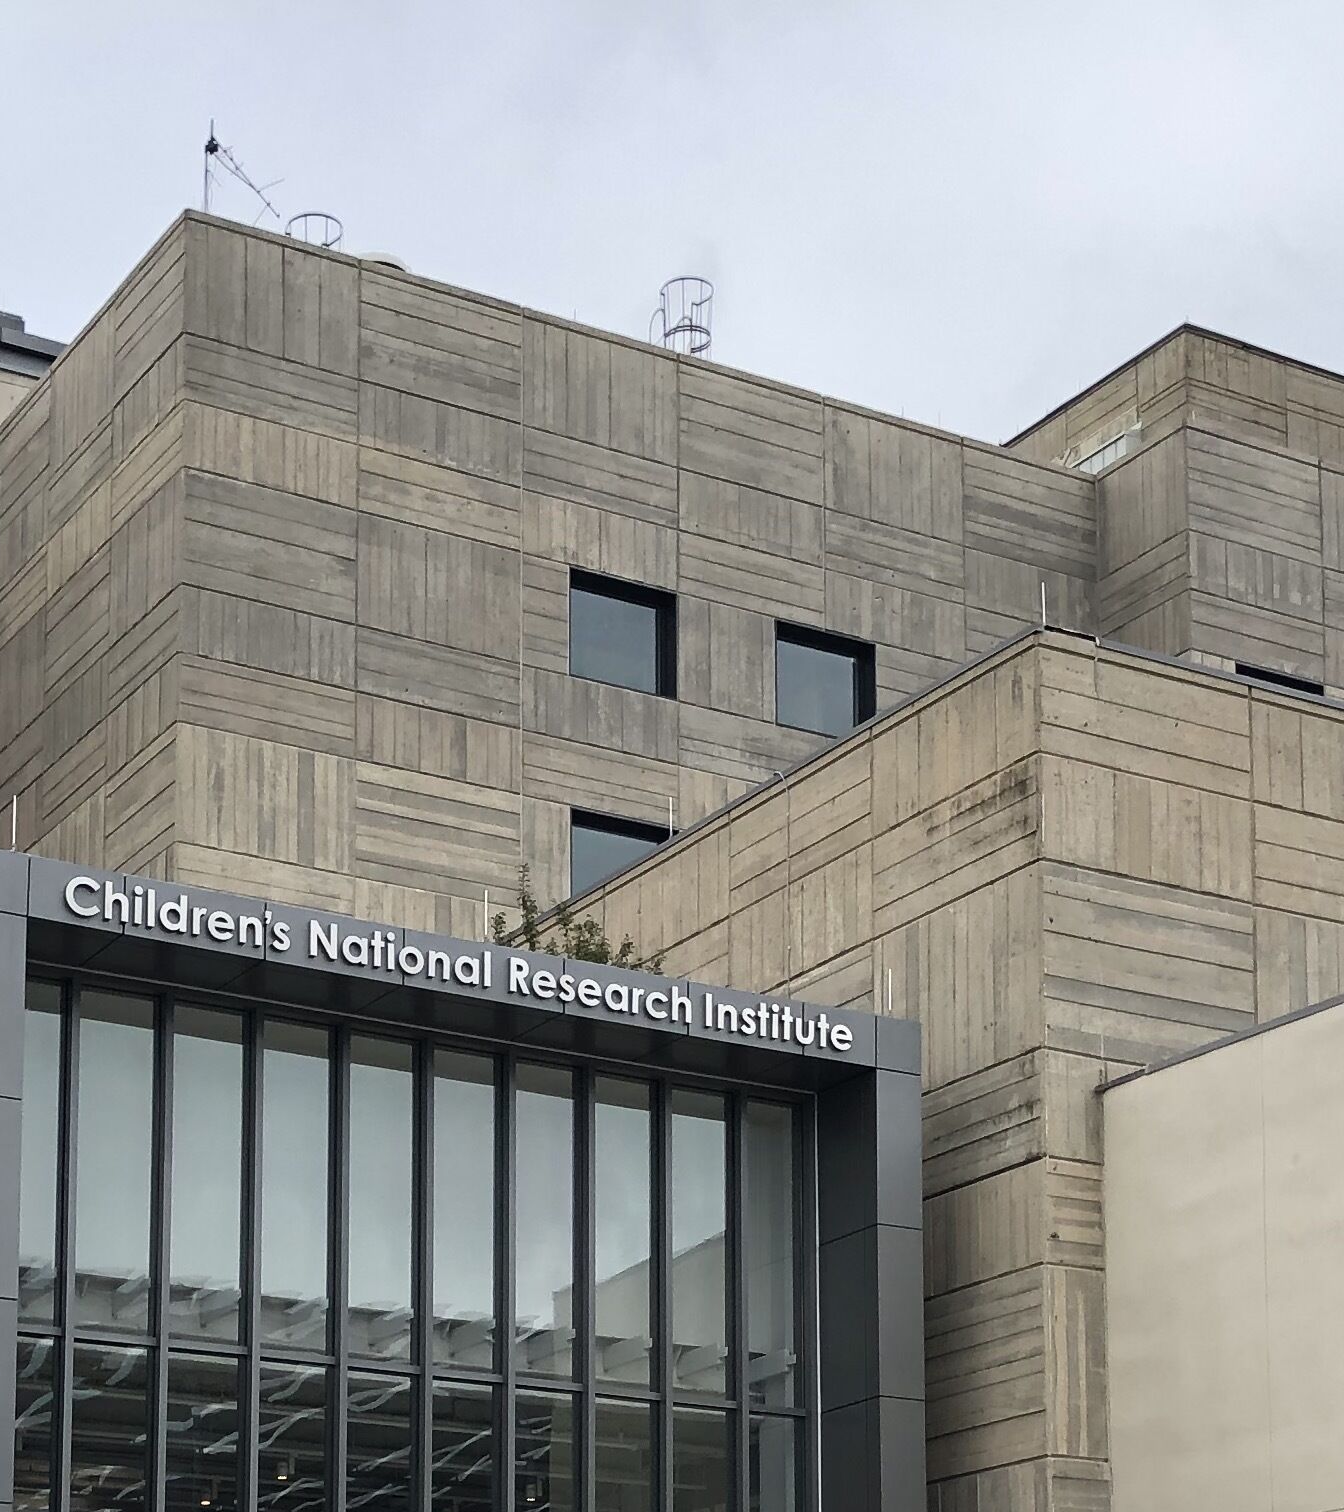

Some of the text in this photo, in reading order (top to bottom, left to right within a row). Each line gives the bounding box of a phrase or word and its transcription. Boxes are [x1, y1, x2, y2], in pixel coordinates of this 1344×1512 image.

[65, 876, 853, 1051] Children's National Research Institute
